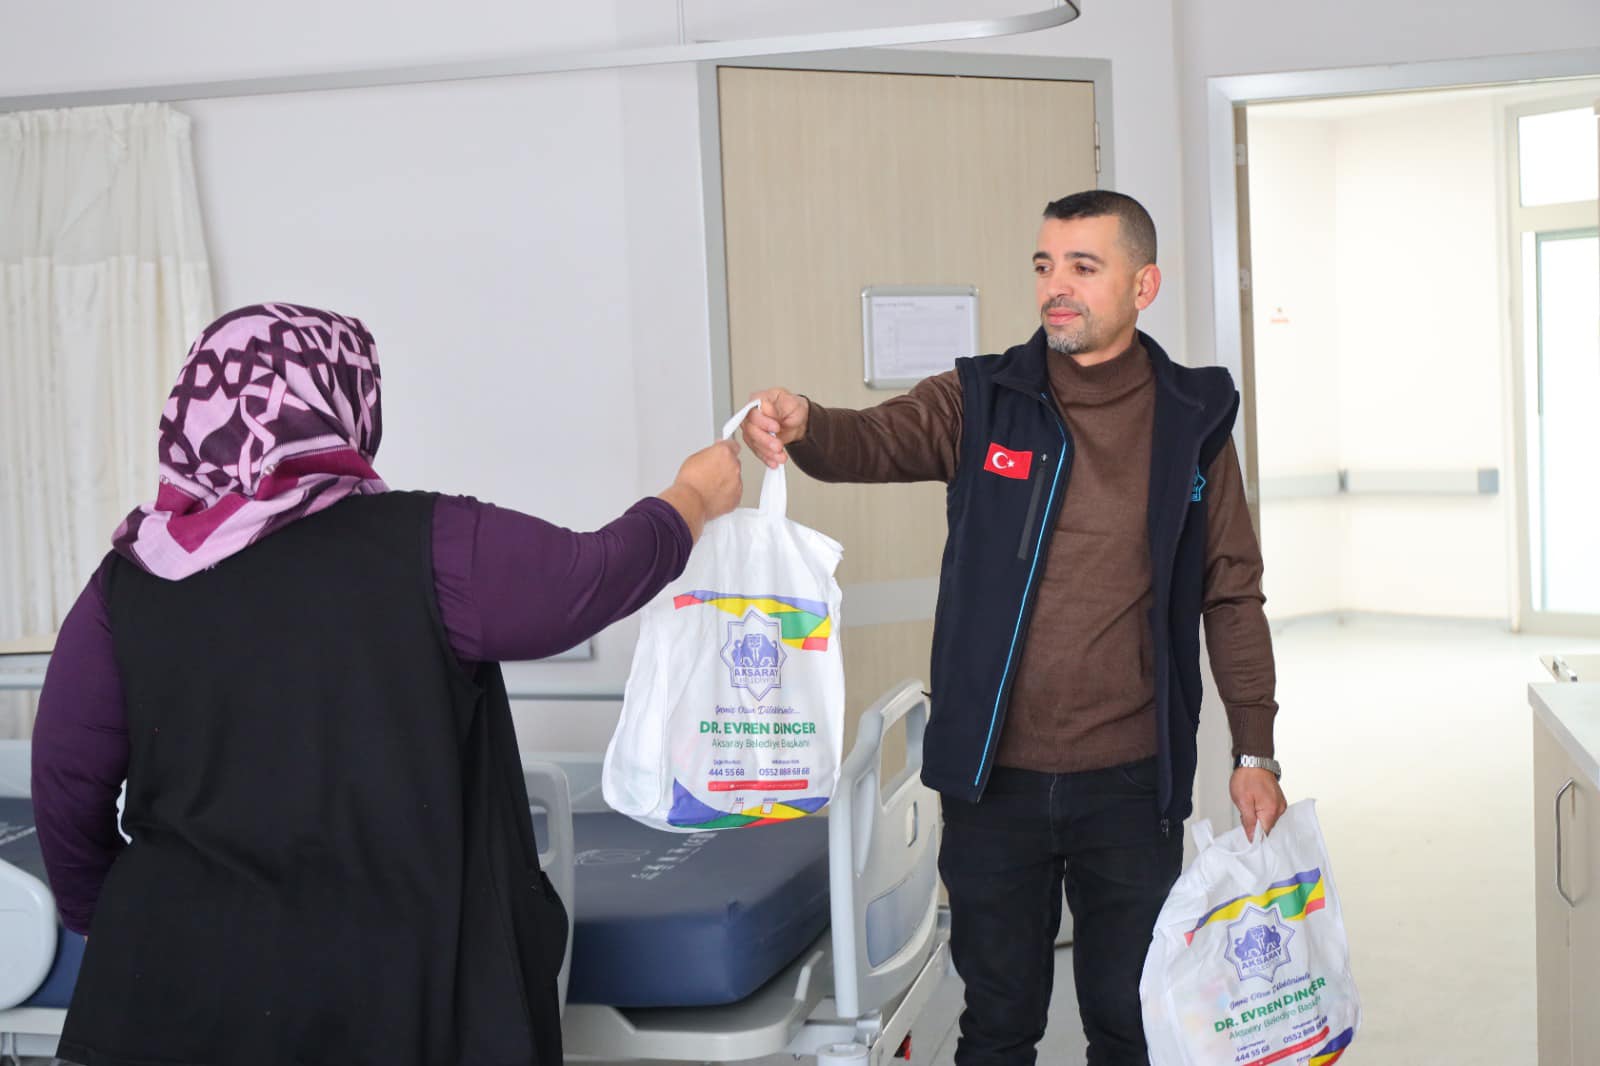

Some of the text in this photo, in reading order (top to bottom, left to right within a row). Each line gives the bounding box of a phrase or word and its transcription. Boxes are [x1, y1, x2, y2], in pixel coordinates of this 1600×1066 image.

[735, 668, 778, 677] AKSARAY
[699, 721, 722, 734] DR.
[724, 722, 770, 735] EVREN
[712, 738, 743, 749] Aksaray
[1241, 949, 1281, 970] AKSARAY
[1214, 1017, 1239, 1032] DR.
[1240, 998, 1283, 1024] EVREN
